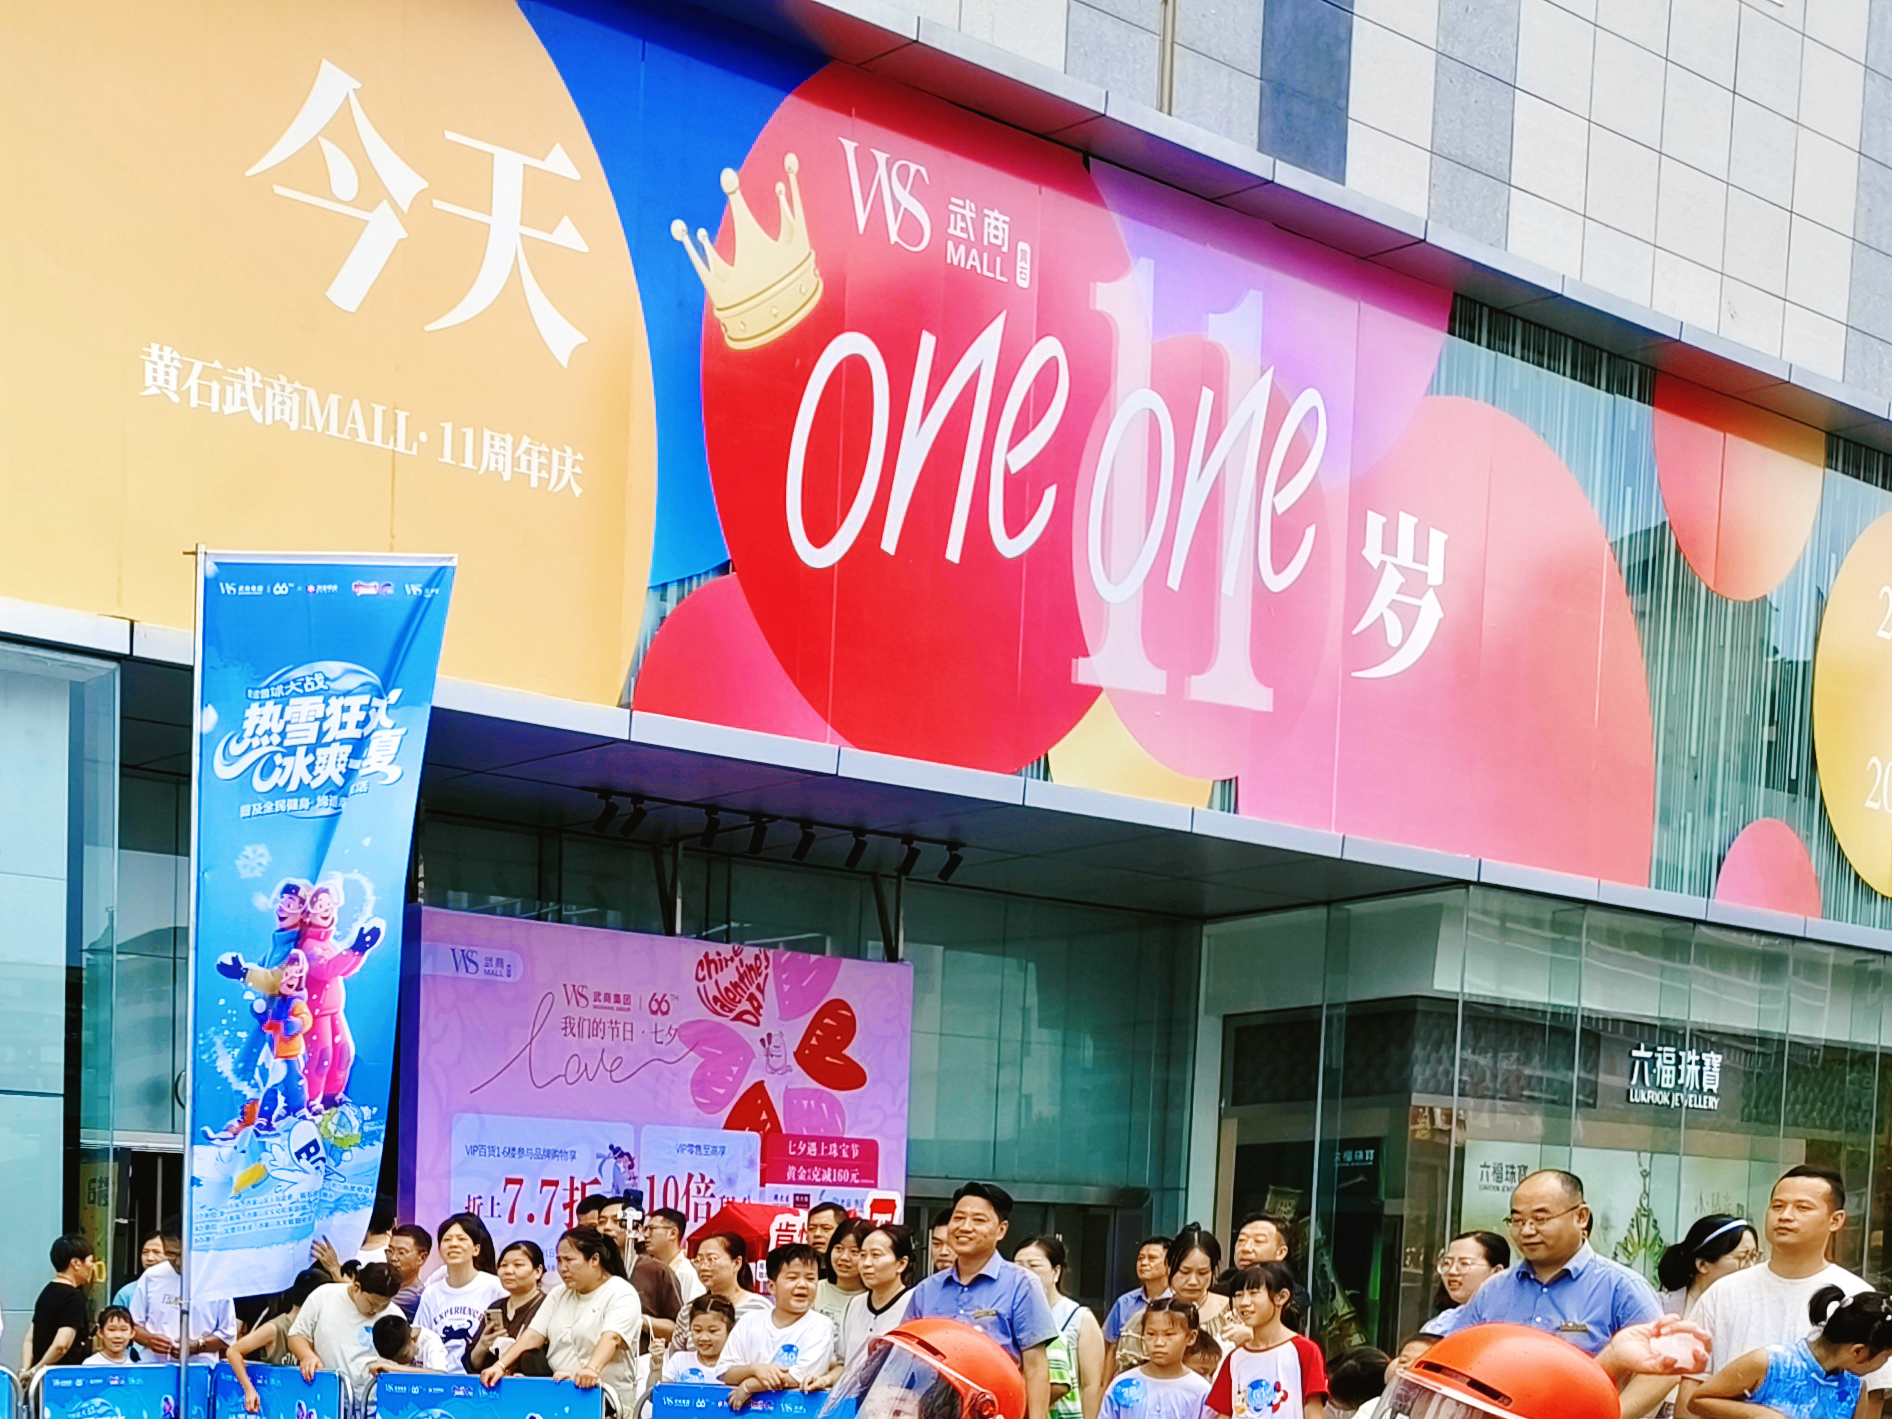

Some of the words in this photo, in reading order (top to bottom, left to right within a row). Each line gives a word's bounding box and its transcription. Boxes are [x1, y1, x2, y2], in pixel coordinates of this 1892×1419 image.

[244, 58, 591, 369] 今天
[837, 137, 932, 253] WS
[946, 196, 1011, 253] 武商
[946, 239, 1009, 283] MALL
[1350, 508, 1450, 680] 岁
[252, 727, 408, 794] 冰爽一夏
[1629, 1043, 1723, 1094] 六福珠寶
[1629, 1088, 1670, 1107] LUKFOOK
[1671, 1091, 1720, 1111] JEWELLERY
[787, 1139, 861, 1160] 七夕遇上珠宝节
